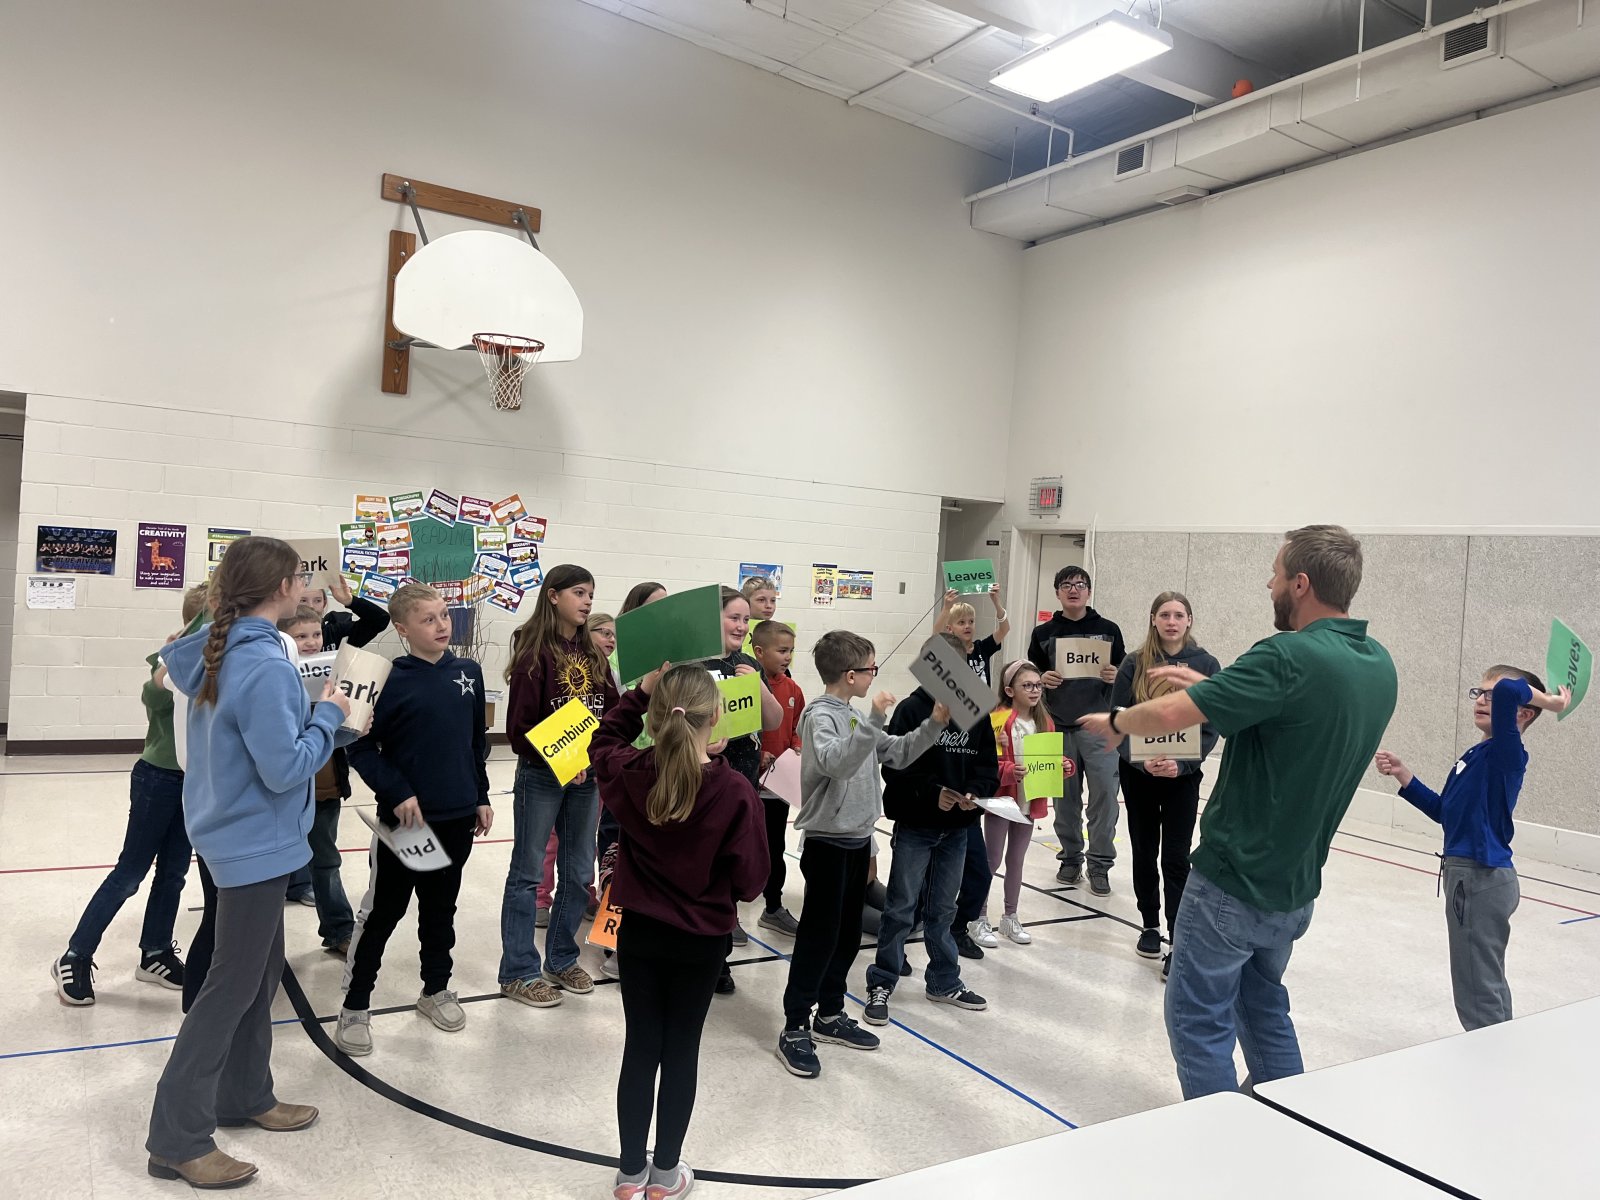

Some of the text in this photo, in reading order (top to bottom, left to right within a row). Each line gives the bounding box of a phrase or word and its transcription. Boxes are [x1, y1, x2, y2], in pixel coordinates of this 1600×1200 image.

[139, 529, 186, 538] CREATIVITY
[412, 525, 473, 546] READING
[300, 556, 328, 573] ark
[947, 570, 993, 583] Leaves
[1066, 651, 1100, 665] Bark
[1566, 638, 1582, 697] eaves
[338, 678, 380, 707] ark
[923, 649, 980, 718] Phloem
[722, 694, 754, 714] lem
[542, 715, 596, 759] Cambium
[1144, 731, 1187, 745] Bark
[1026, 760, 1055, 774] Xylem
[399, 836, 437, 859] Phl
